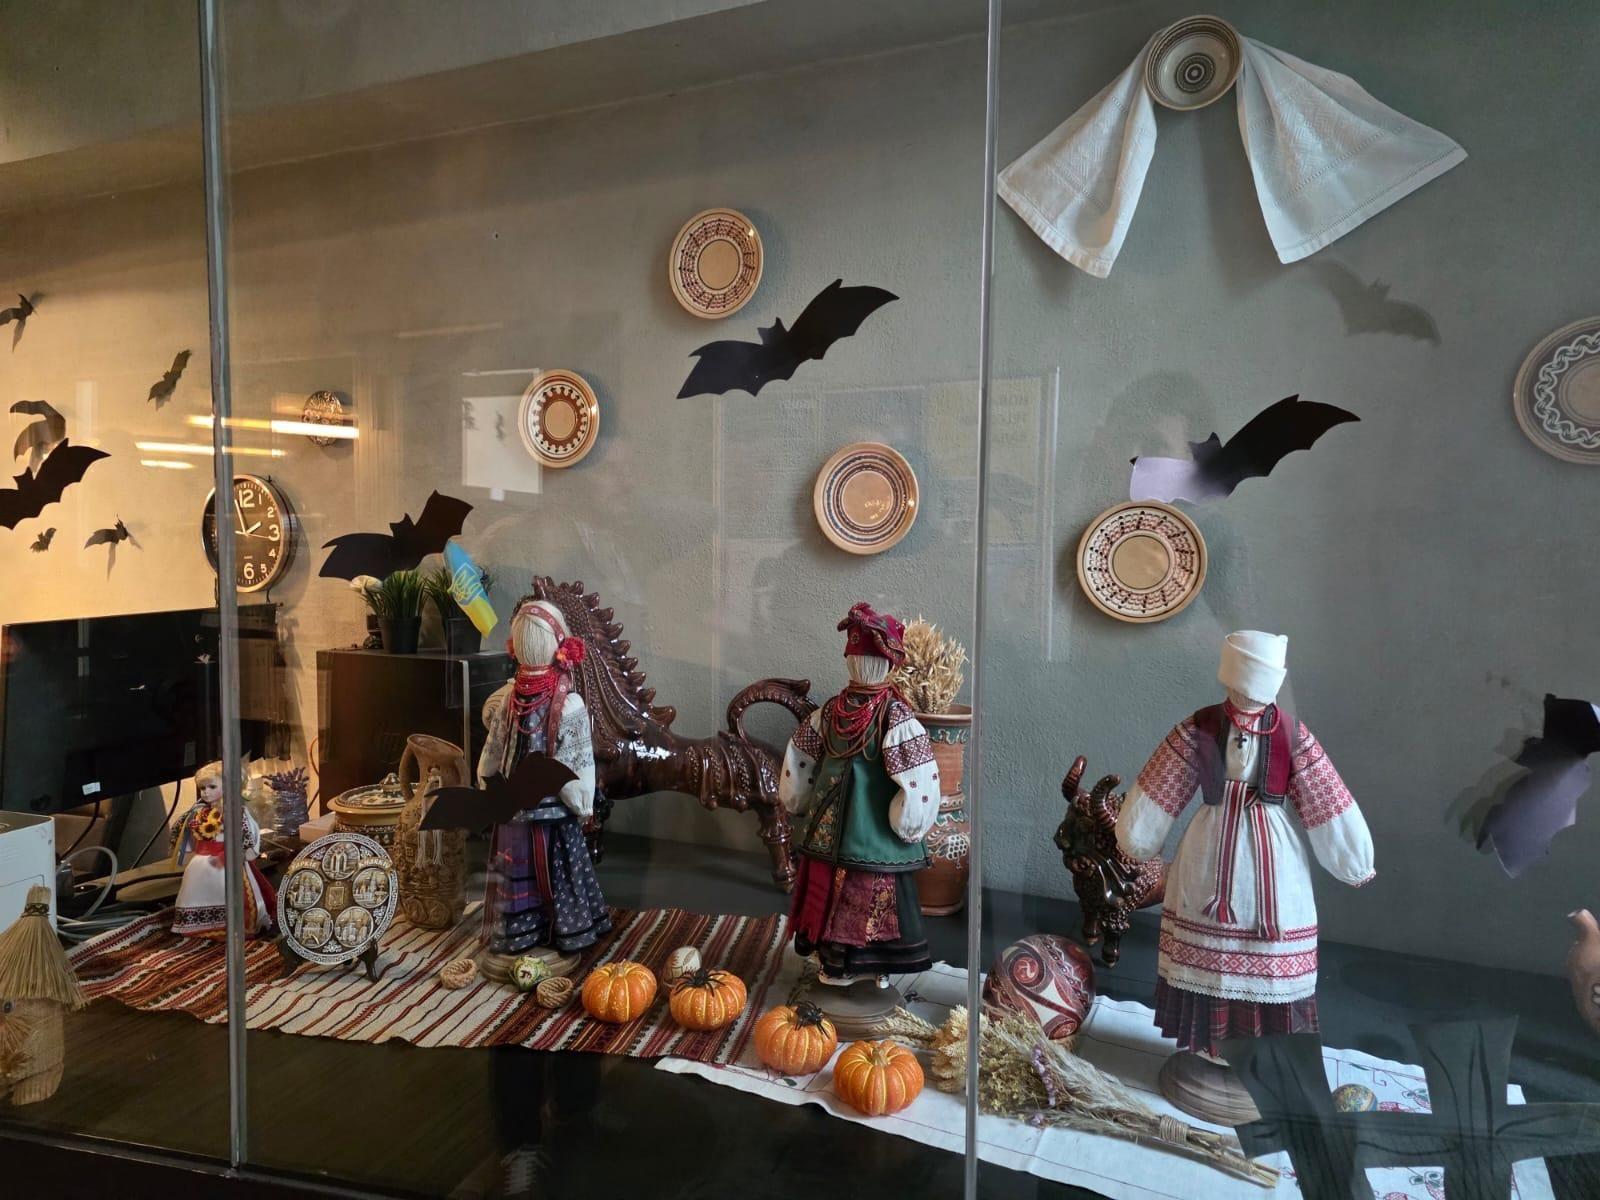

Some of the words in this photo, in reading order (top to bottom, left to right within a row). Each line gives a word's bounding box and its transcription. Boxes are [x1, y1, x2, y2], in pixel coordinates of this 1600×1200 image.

[238, 489, 256, 508] 12
[267, 506, 275, 518] 2
[268, 524, 280, 541] 3
[268, 548, 276, 558] 4
[243, 562, 255, 580] 6
[260, 563, 267, 573] 5
